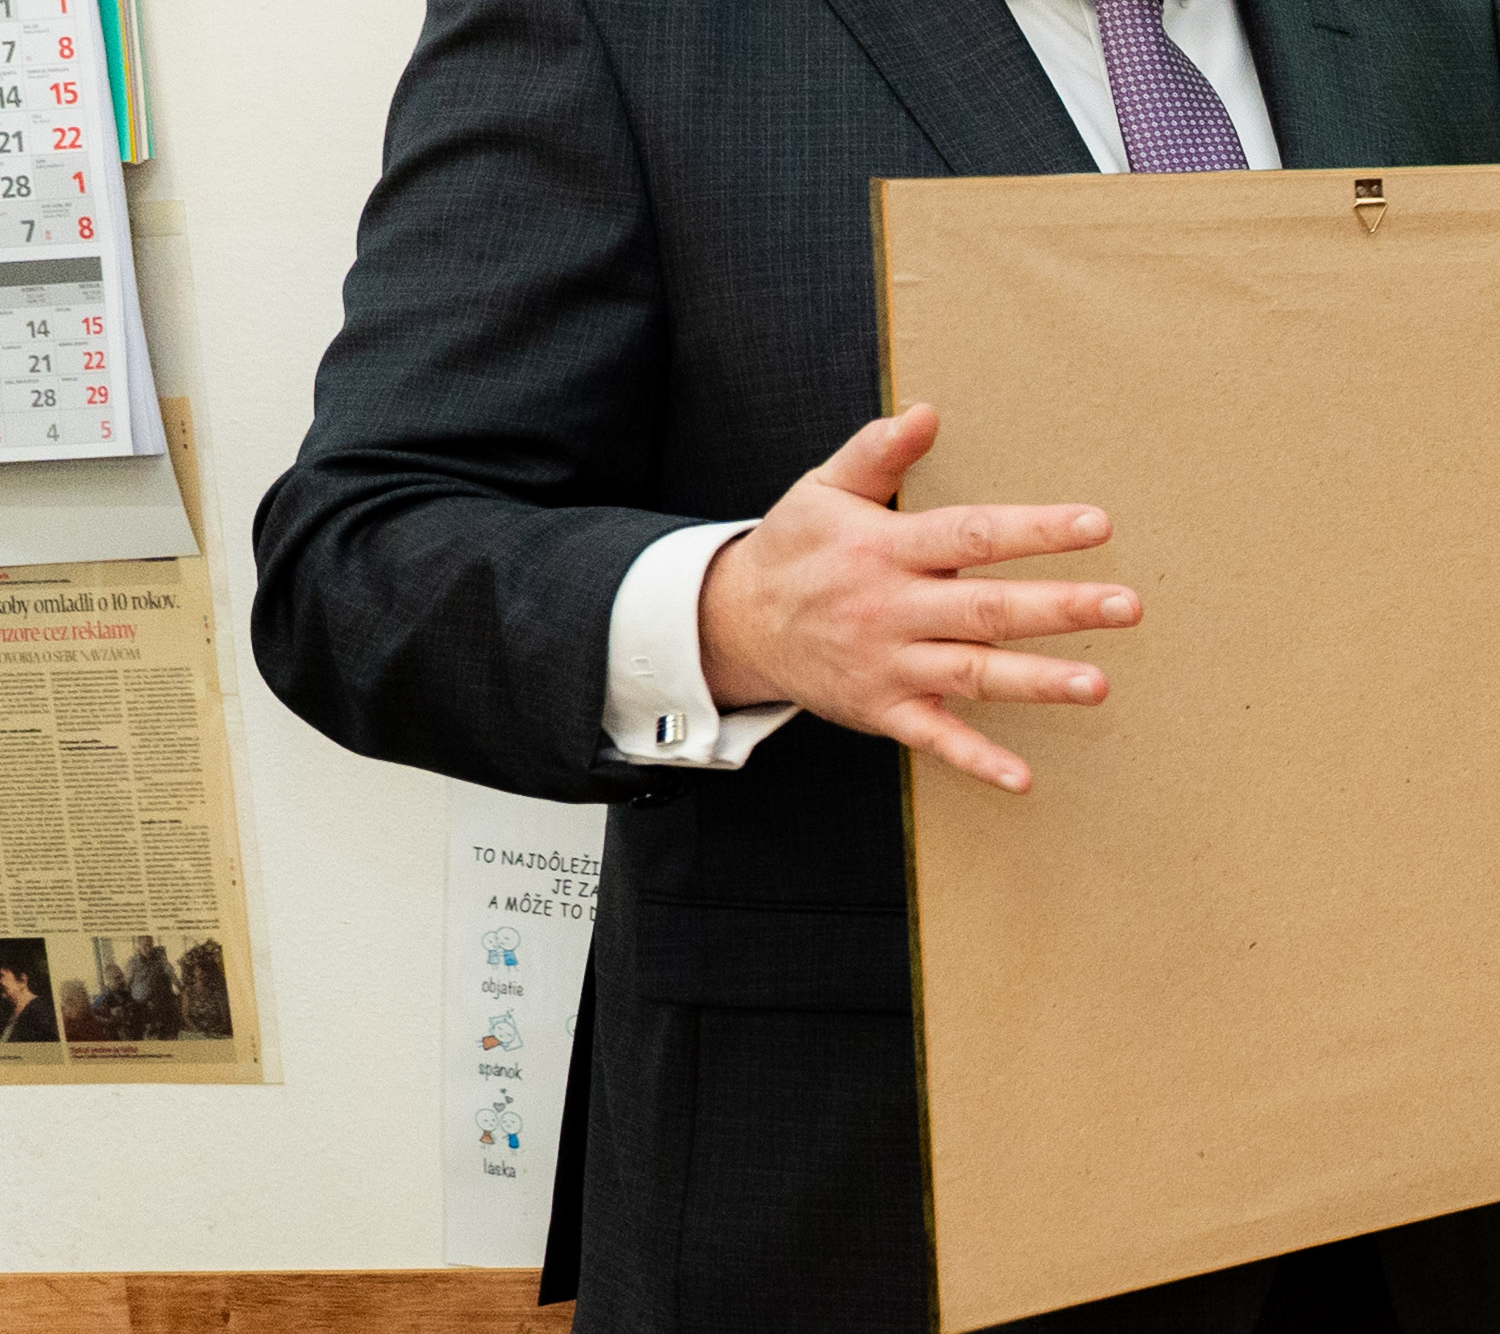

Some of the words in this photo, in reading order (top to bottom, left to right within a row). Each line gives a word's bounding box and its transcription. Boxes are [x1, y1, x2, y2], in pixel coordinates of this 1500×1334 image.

[2, 40, 16, 64] 7
[58, 35, 75, 60] 8
[0, 85, 22, 109] 14
[49, 81, 78, 105] 15
[0, 130, 24, 154] 21
[52, 126, 82, 150] 22
[0, 174, 32, 199] 28
[72, 171, 86, 194] 1
[20, 219, 35, 243] 7
[77, 215, 94, 240] 8
[26, 319, 50, 338] 14
[81, 315, 104, 335] 15
[28, 353, 52, 373] 21
[82, 350, 106, 371] 22
[30, 388, 57, 408] 28
[85, 385, 109, 406] 29
[46, 423, 60, 442] 4
[100, 420, 112, 439] 5
[34, 592, 95, 614] omladli
[98, 598, 109, 611] o
[132, 590, 181, 611] rokov.
[71, 620, 138, 643] reklamy
[473, 846, 496, 864] TO
[501, 850, 600, 876] NAJDÔLEŽI
[551, 878, 573, 896] JE
[578, 881, 599, 898] ZA
[488, 895, 499, 910] A
[505, 892, 553, 917] MÔŽE
[560, 902, 583, 920] TO
[482, 977, 525, 1000] objatie
[478, 1062, 523, 1081] spánok
